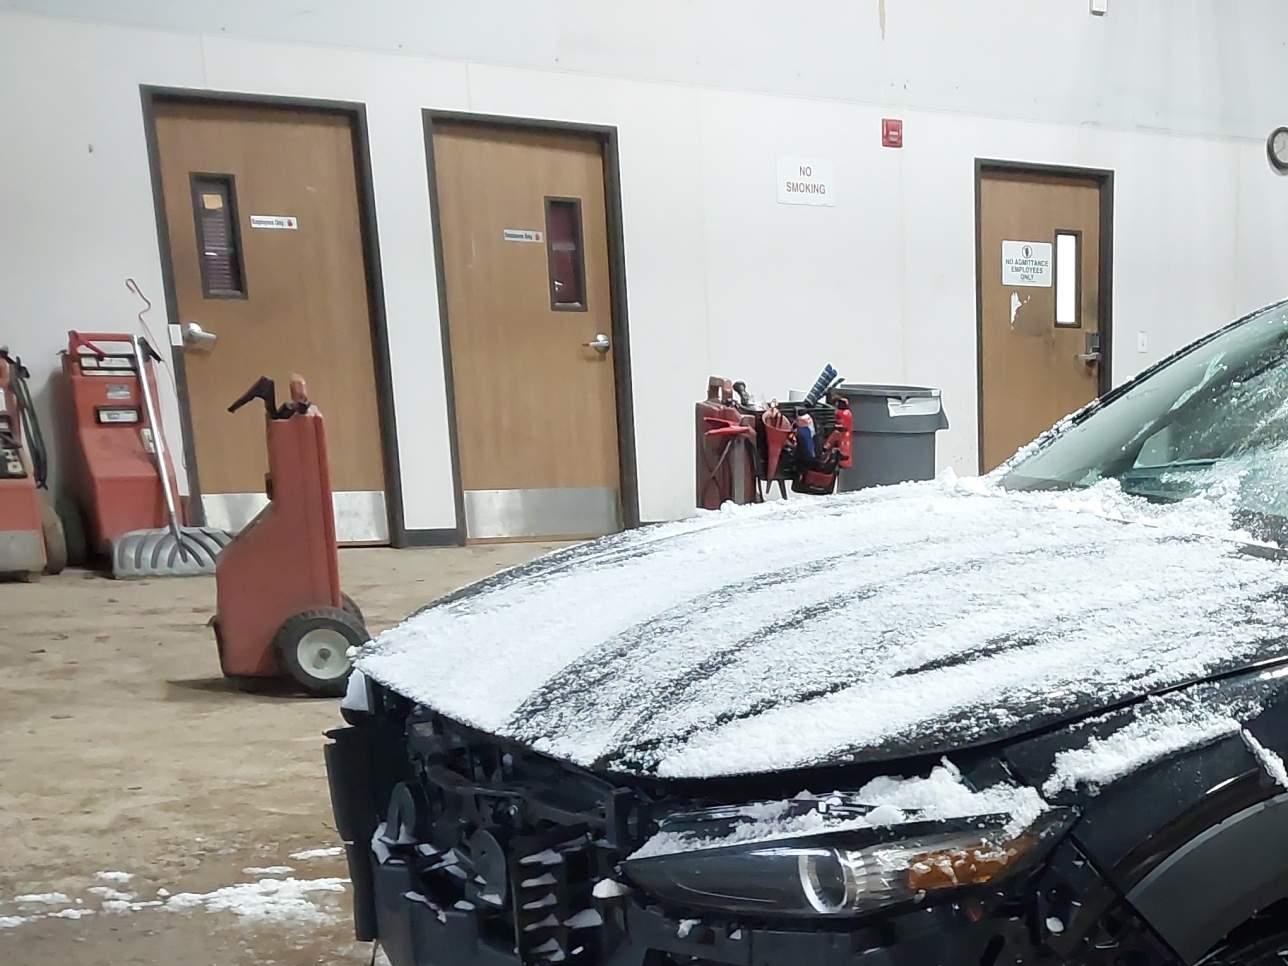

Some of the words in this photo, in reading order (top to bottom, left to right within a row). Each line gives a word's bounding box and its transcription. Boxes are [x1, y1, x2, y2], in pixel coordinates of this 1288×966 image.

[799, 166, 812, 177] NO
[786, 181, 826, 195] SMOKING
[1011, 266, 1043, 274] EMPLOYEES
[1020, 273, 1034, 281] ONLY
